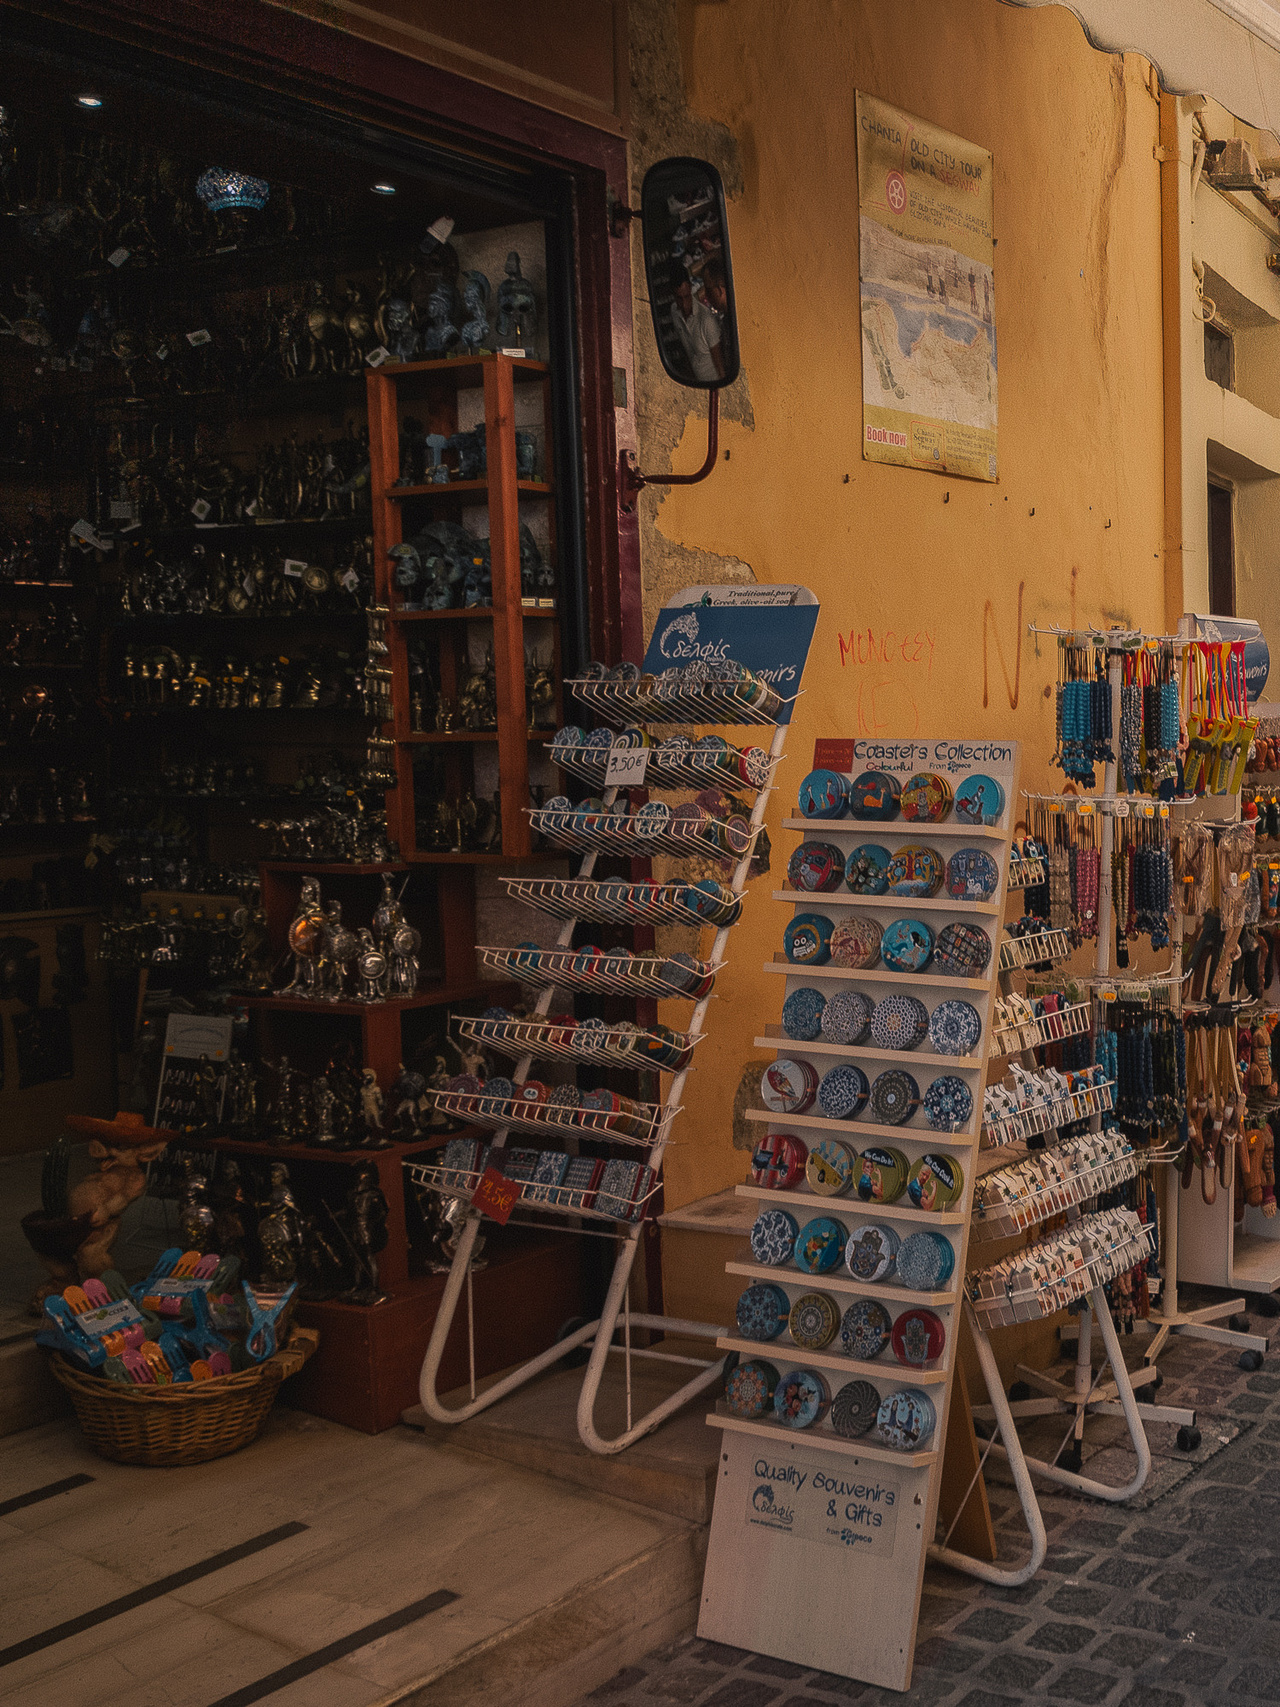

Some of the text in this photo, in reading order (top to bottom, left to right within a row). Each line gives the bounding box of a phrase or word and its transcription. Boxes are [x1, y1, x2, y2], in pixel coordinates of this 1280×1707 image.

[861, 116, 982, 181] CHANIA OLD CITY TOUR
[910, 156, 980, 197] ON A SEGWAY
[866, 426, 906, 447] Book now
[854, 742, 928, 760] Coasters
[934, 742, 1011, 761] Collection
[866, 761, 913, 771] Colourful
[864, 1151, 871, 1159] We
[872, 1153, 881, 1162] Can
[881, 1156, 888, 1164] Do
[925, 1155, 932, 1165] We
[931, 1161, 940, 1174] Can
[939, 1169, 950, 1184] Cook
[754, 1459, 895, 1506] Quality Souvenirs
[826, 1499, 883, 1527] & Gifts
[826, 1527, 840, 1535] from
